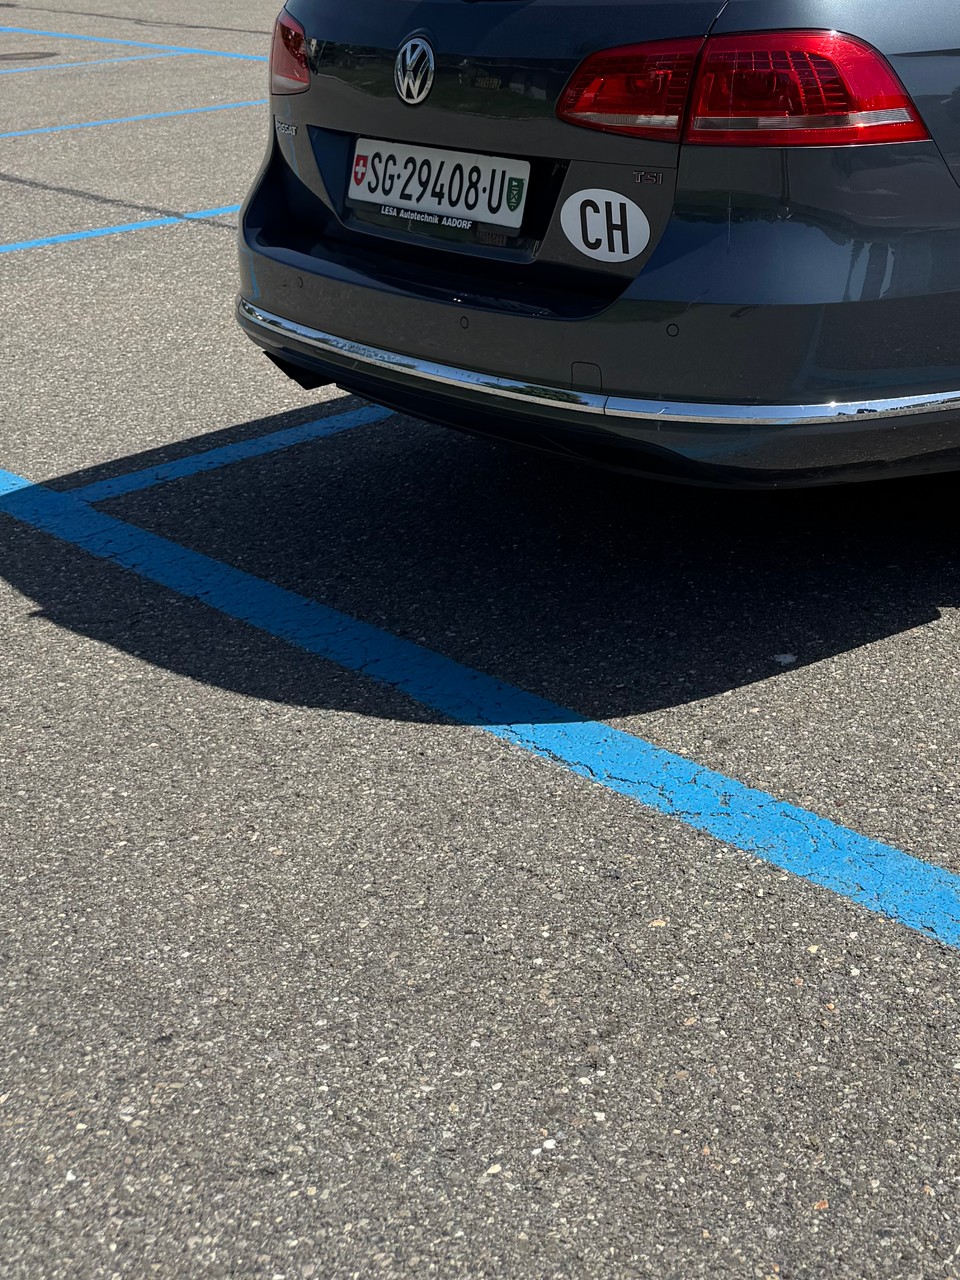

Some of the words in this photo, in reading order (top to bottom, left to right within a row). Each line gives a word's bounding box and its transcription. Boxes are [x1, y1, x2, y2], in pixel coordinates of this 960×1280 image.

[394, 37, 435, 104] VW
[633, 170, 663, 185] TSI
[380, 205, 398, 218] LESA
[399, 208, 440, 225] Autotechnik
[441, 216, 473, 231] AADORF
[579, 199, 630, 255] CH
